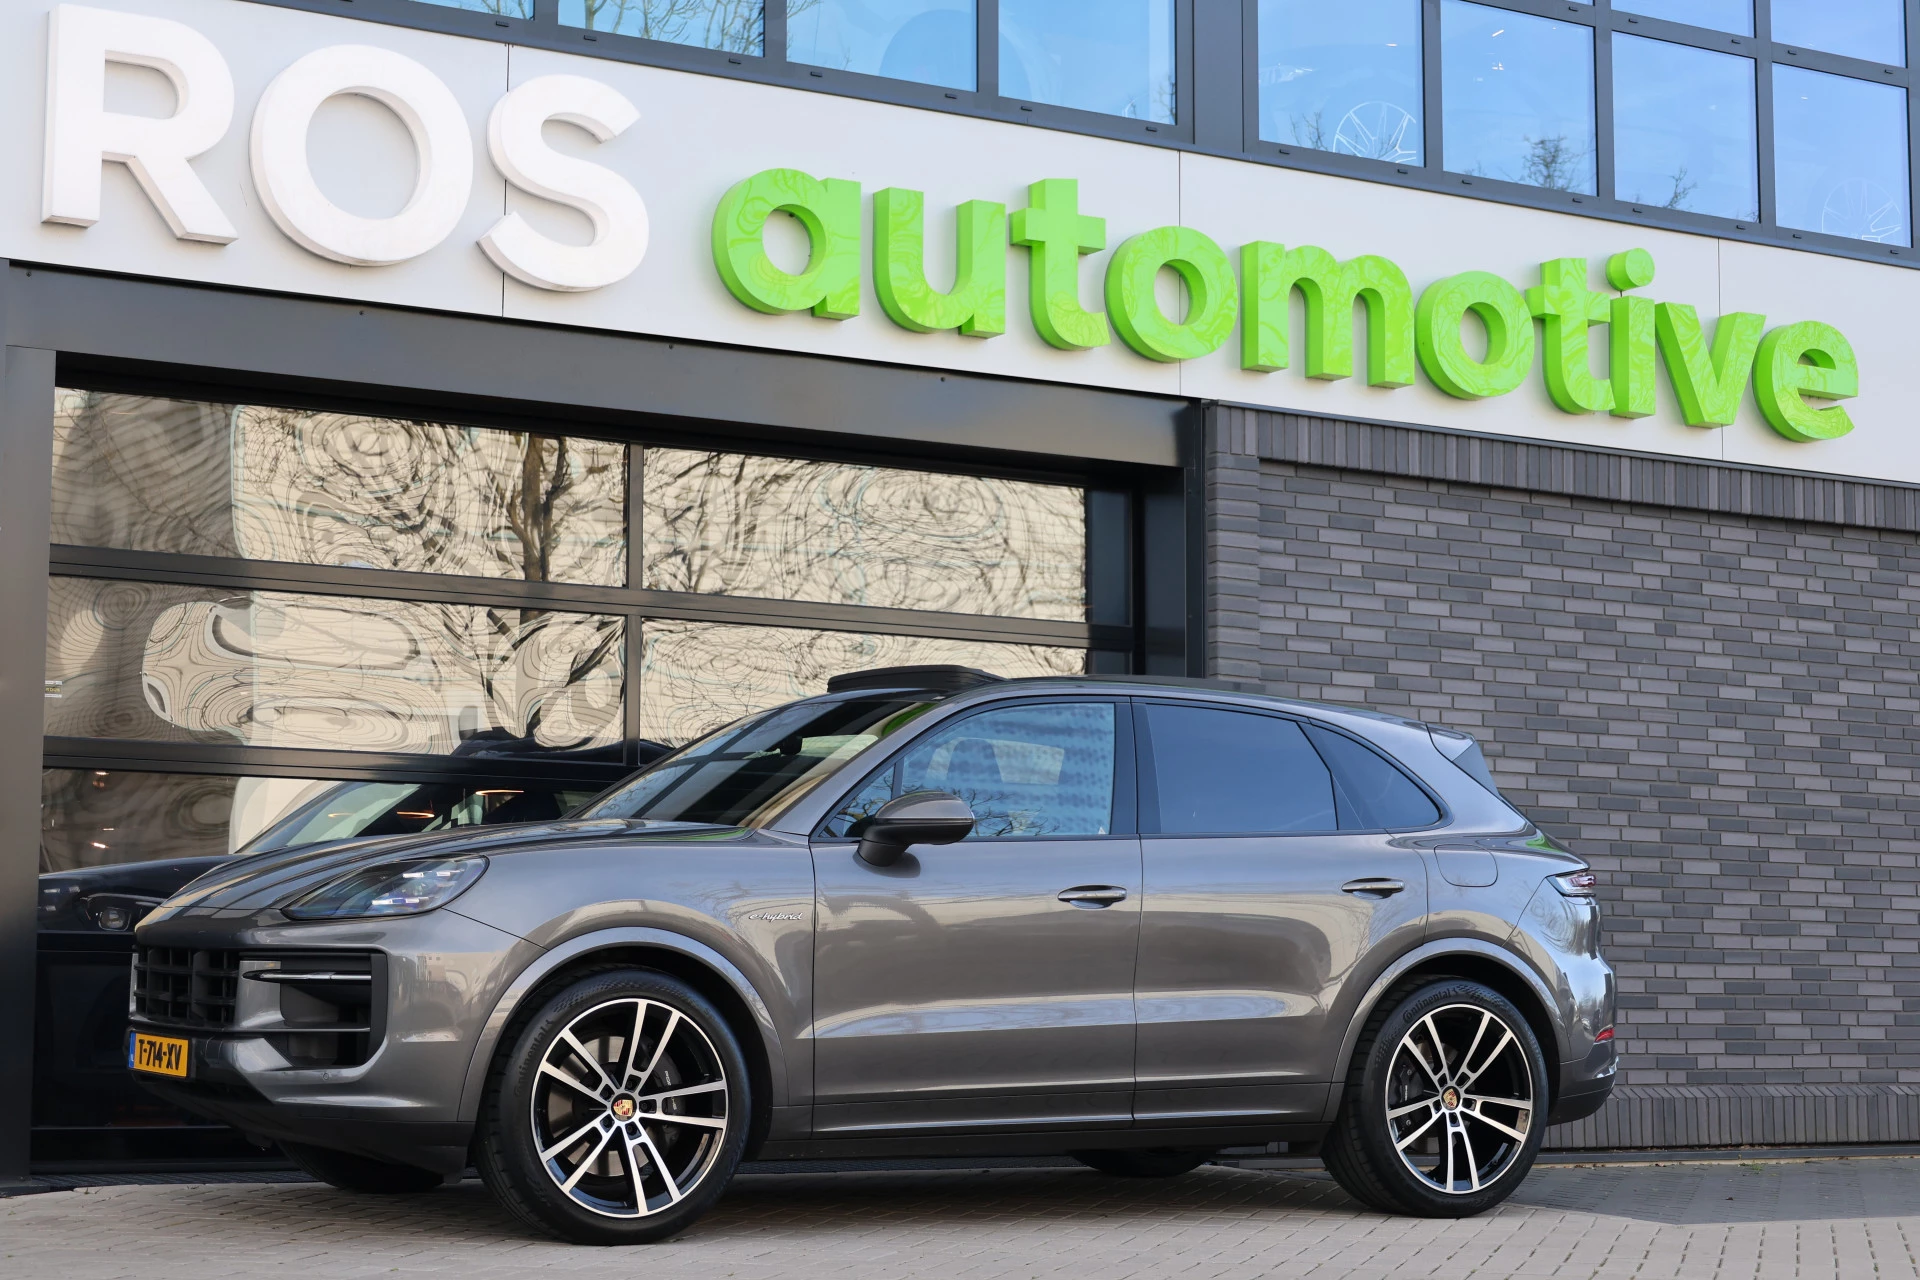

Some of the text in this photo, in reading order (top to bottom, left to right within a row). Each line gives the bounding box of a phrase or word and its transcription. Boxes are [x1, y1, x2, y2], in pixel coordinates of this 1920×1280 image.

[41, 3, 1860, 443] ROS automotive
[748, 912, 803, 922] e-hybrid
[1402, 987, 1452, 1022] Continental
